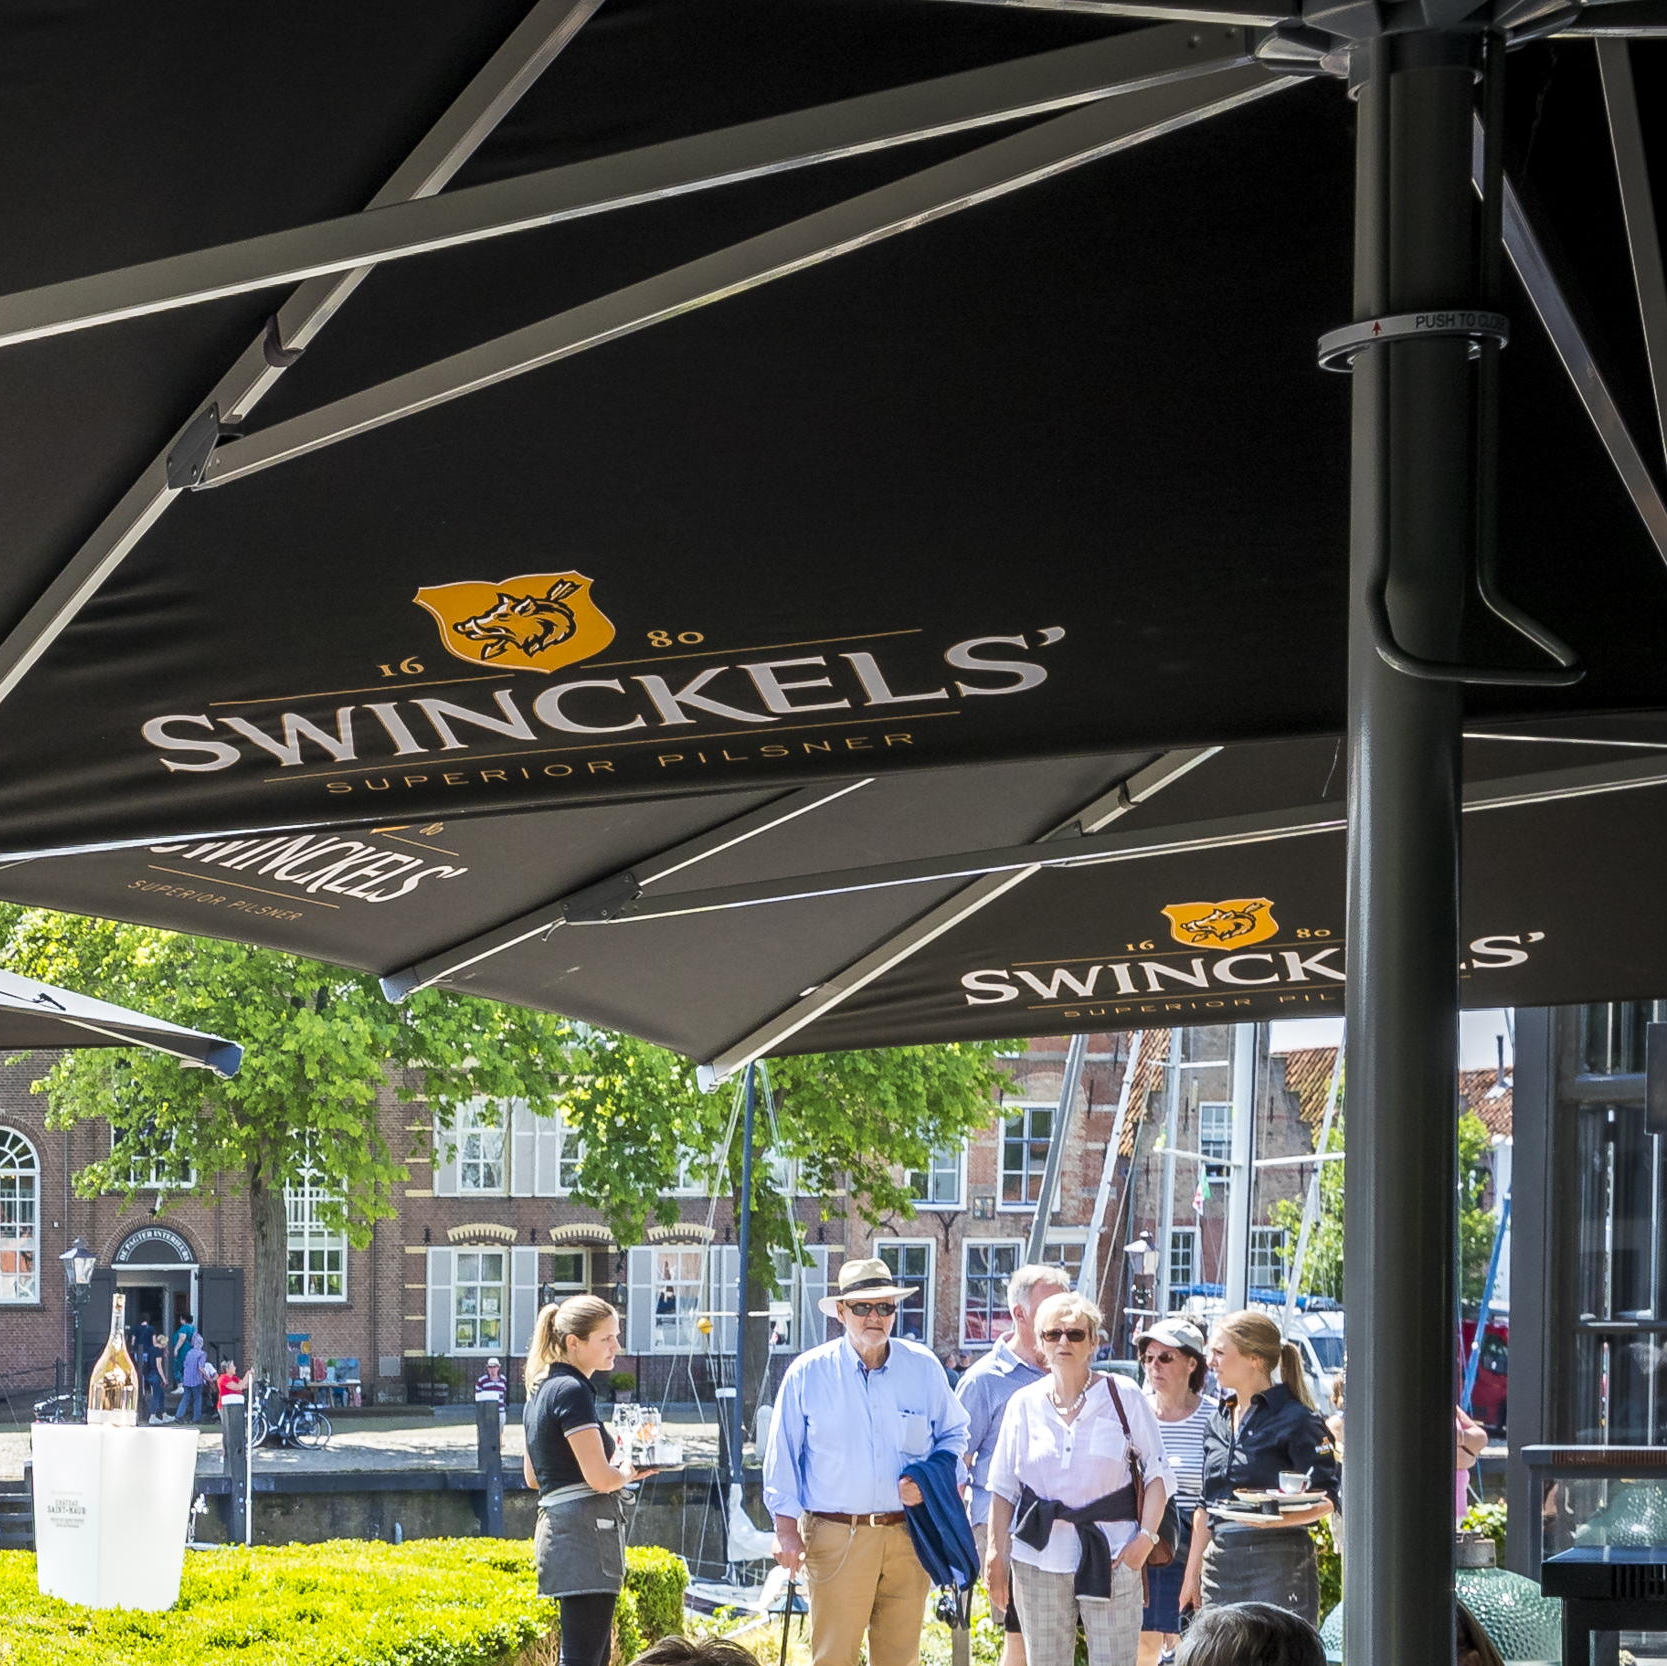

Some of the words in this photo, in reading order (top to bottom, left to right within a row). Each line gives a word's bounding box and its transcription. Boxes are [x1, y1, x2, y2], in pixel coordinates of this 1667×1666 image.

[1415, 313, 1456, 330] PUSH
[1460, 312, 1477, 328] TO
[375, 656, 426, 678] 16
[646, 629, 704, 648] 80
[141, 626, 1067, 773] SWINCKELS'
[325, 760, 616, 794] SUPERIOR
[657, 733, 915, 768] PILSNER
[148, 835, 469, 903] WINCKELS'
[126, 879, 229, 908] SUPERIOR
[226, 899, 305, 923] PILSNER
[1125, 939, 1155, 951] 16
[1296, 928, 1332, 939] 80
[960, 931, 1546, 1006] SWINCKS'
[1063, 998, 1252, 1018] SUPERIOR
